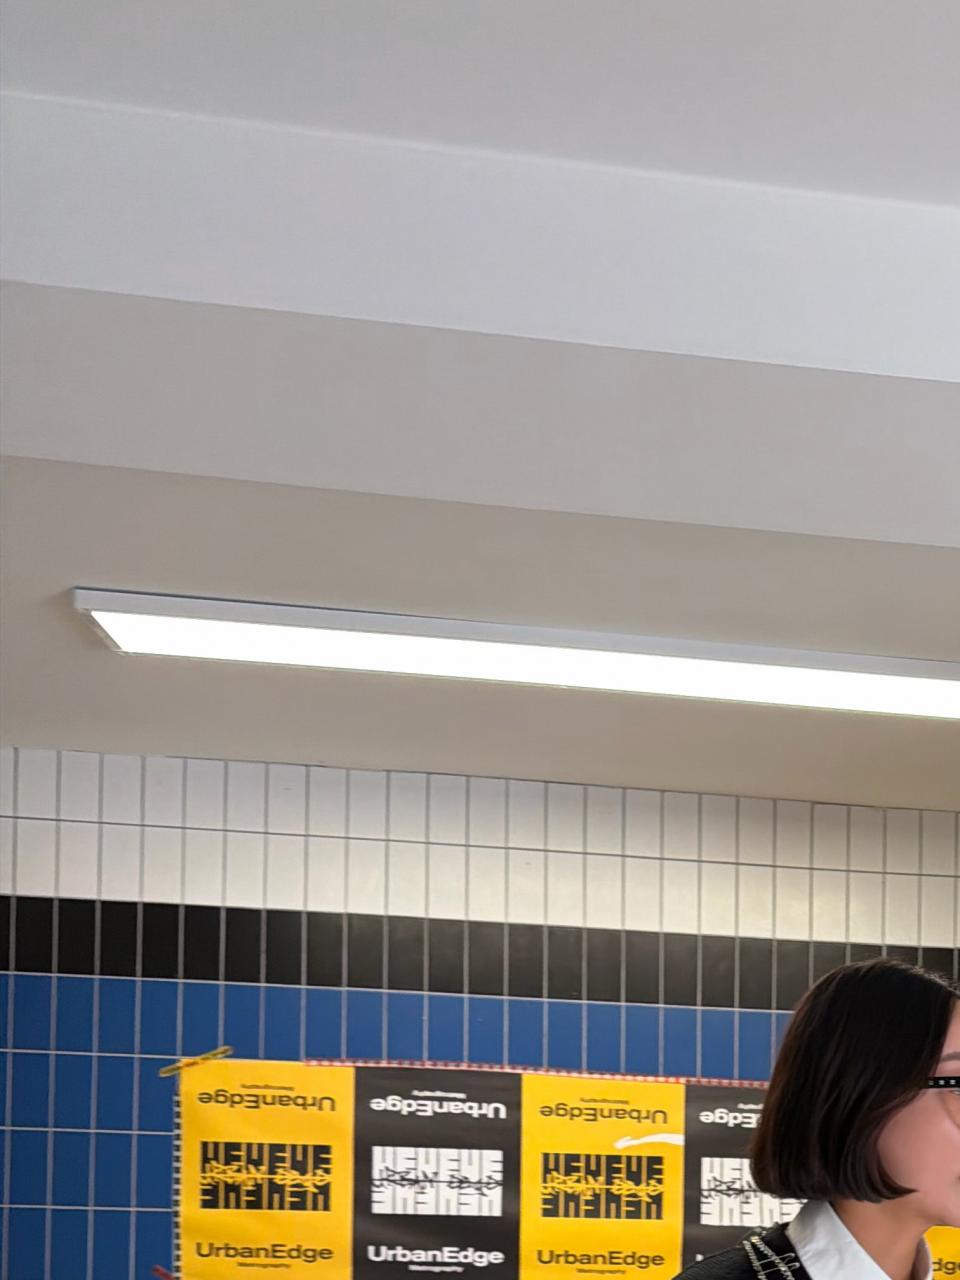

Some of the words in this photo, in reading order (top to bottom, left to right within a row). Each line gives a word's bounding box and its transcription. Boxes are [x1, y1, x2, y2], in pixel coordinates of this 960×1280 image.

[198, 1089, 336, 1112] UrbanEdge
[369, 1095, 507, 1119] UrbanEdge
[538, 1102, 668, 1124] UrbanEdge
[195, 1242, 334, 1263] UrbanEdge
[367, 1245, 505, 1267] UrbanEdge
[536, 1249, 665, 1269] UrbanEdge
